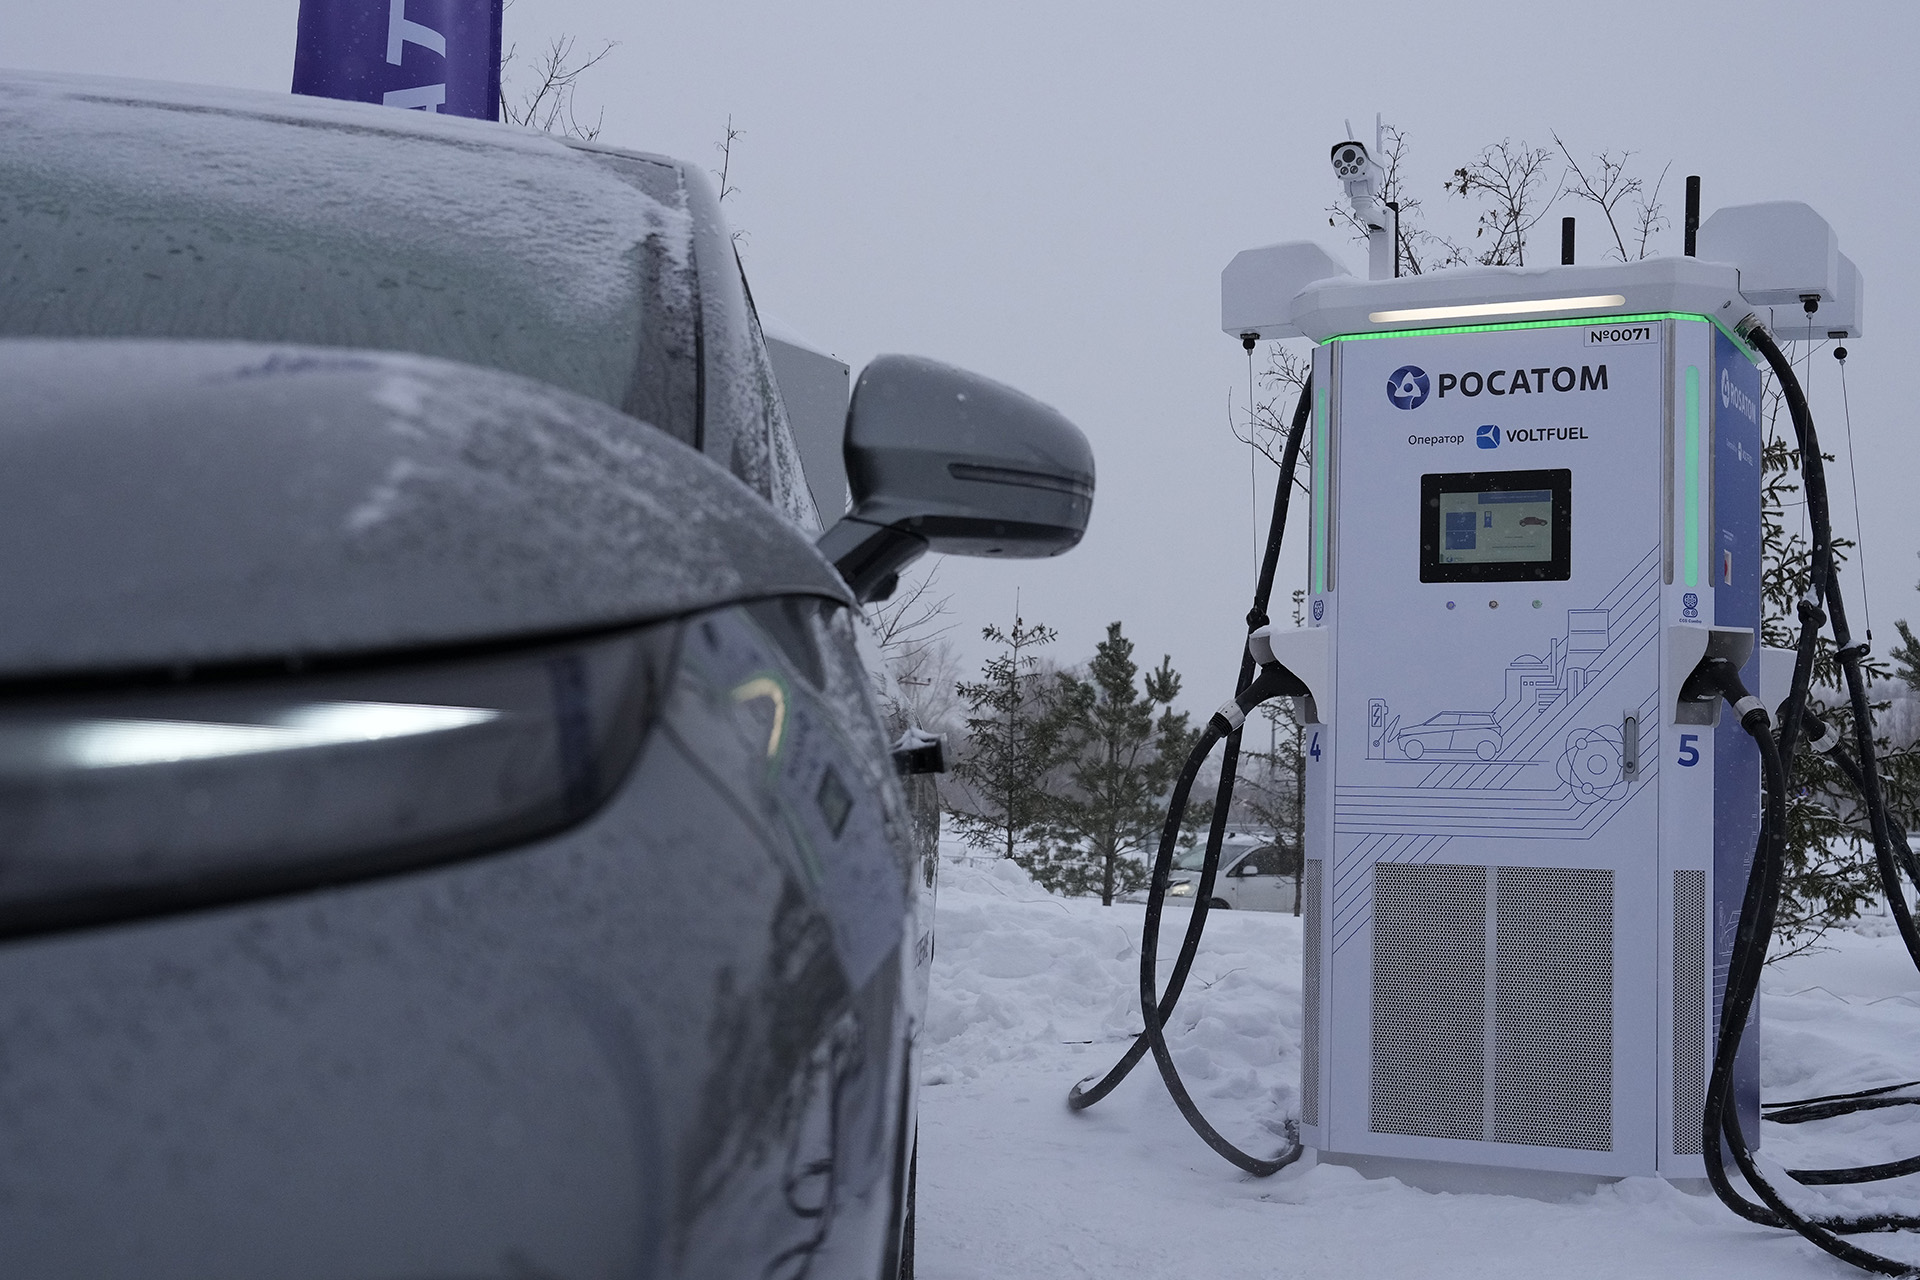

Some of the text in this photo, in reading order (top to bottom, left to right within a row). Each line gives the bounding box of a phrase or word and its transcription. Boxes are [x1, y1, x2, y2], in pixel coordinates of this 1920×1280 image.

[1590, 327, 1651, 343] №0071
[1438, 364, 1609, 398] РОСАТОМ
[1408, 434, 1465, 447] Оператор
[1506, 427, 1589, 443] VOLTFUEL
[1310, 731, 1322, 763] 4
[1677, 734, 1700, 767] 5
